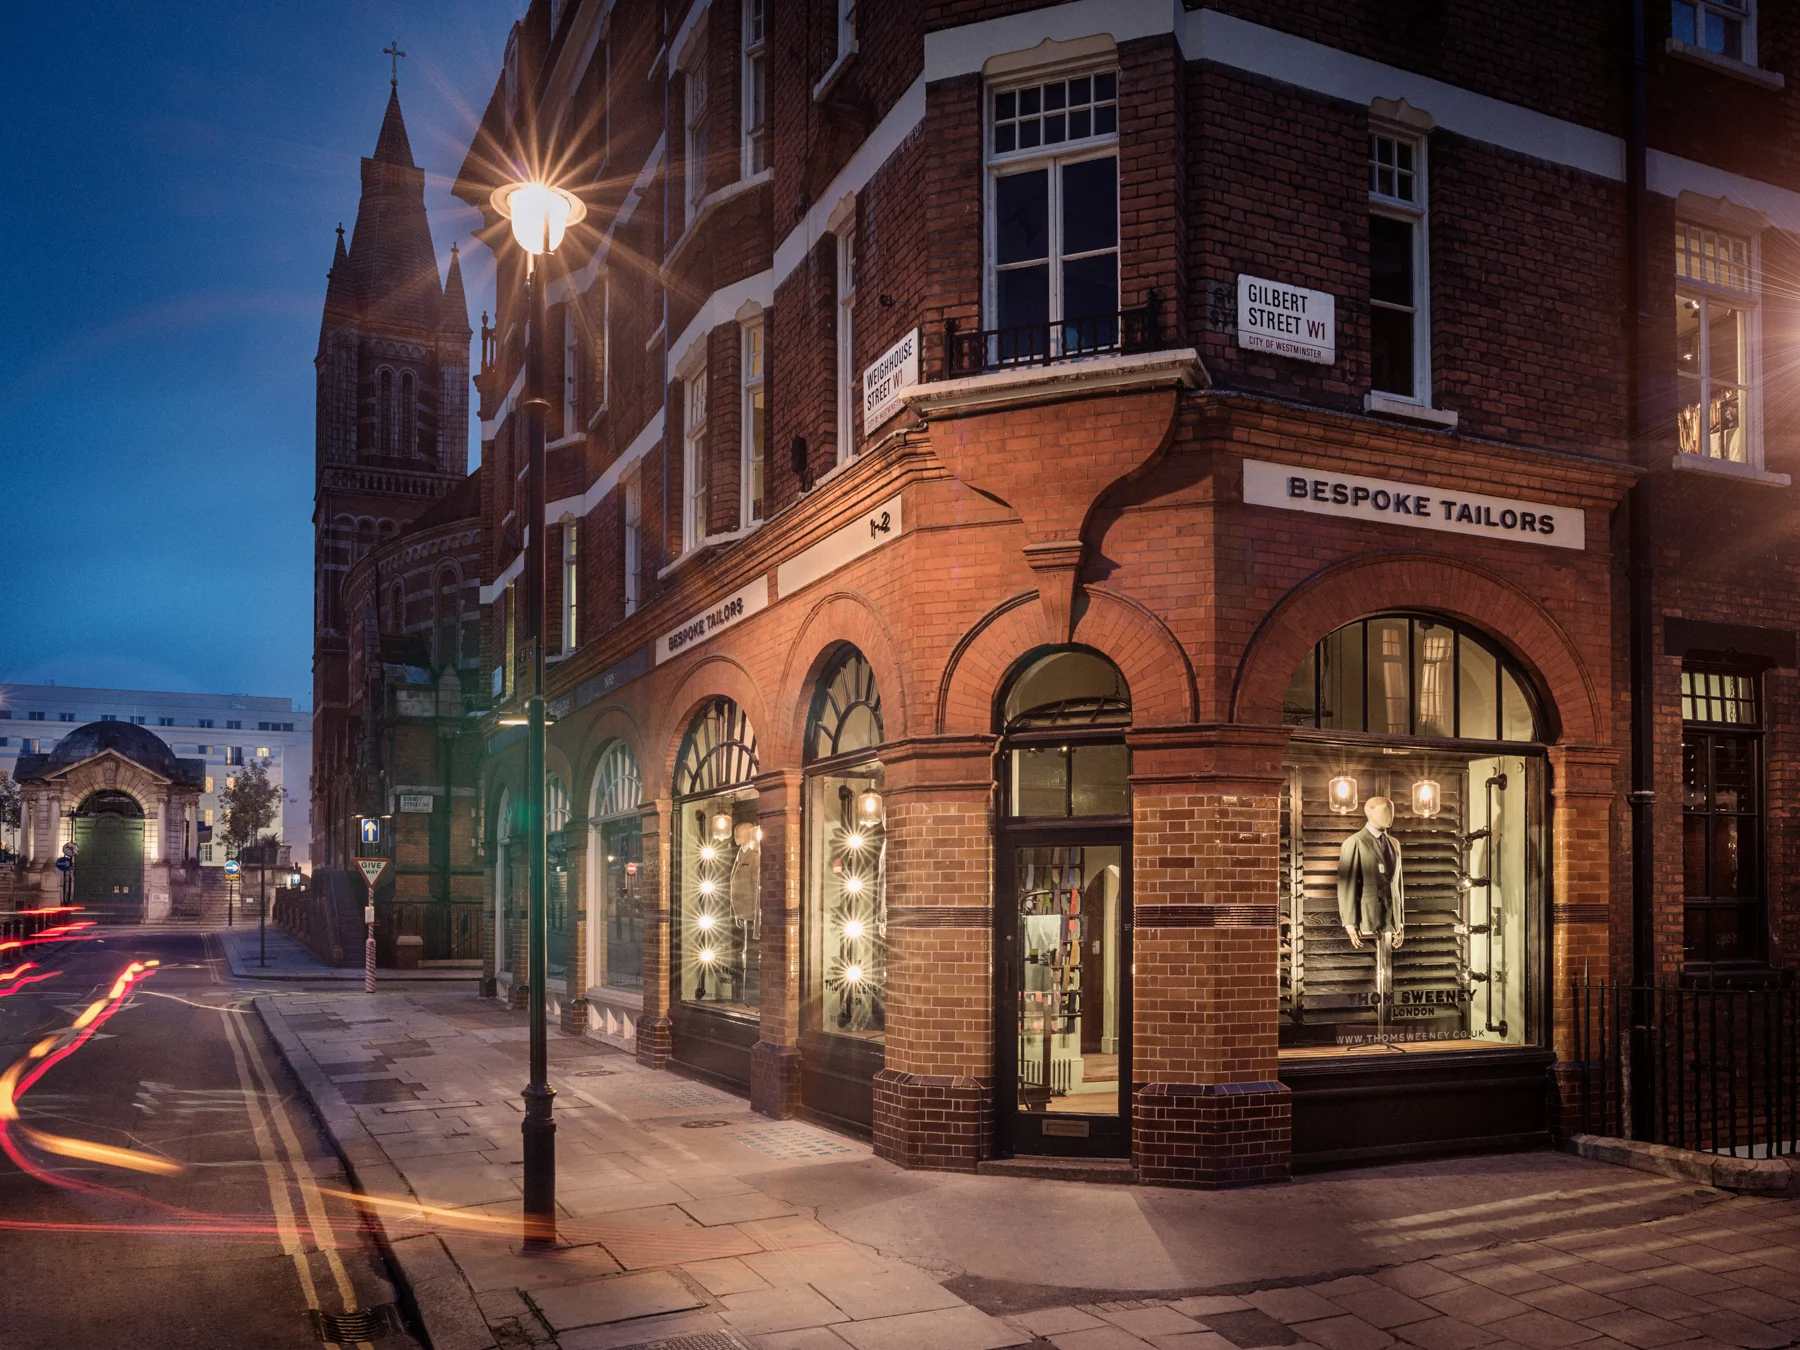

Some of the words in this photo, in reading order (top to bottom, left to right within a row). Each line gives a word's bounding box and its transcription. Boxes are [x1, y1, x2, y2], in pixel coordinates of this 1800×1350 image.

[1249, 284, 1308, 313] GILBERT
[1249, 307, 1301, 335] STREET
[1306, 319, 1325, 340] W1
[1249, 336, 1263, 347] CITY
[1266, 339, 1274, 348] OF
[1276, 341, 1322, 358] WESTMINSTER
[867, 338, 913, 390] WEIGHHOUSE
[867, 378, 891, 411] STREET
[893, 368, 903, 389] W1
[1287, 476, 1431, 517] BESPOKE
[1440, 500, 1555, 535] TAILORS
[668, 619, 705, 651] BESPOKE
[706, 597, 744, 631] TAILORS
[1348, 991, 1394, 1006] THOM
[1400, 989, 1477, 1004] SWEENEY
[1392, 1007, 1435, 1017] LONDON
[1335, 1029, 1485, 1044] WWW.THOMSWEENEYCO.UK
